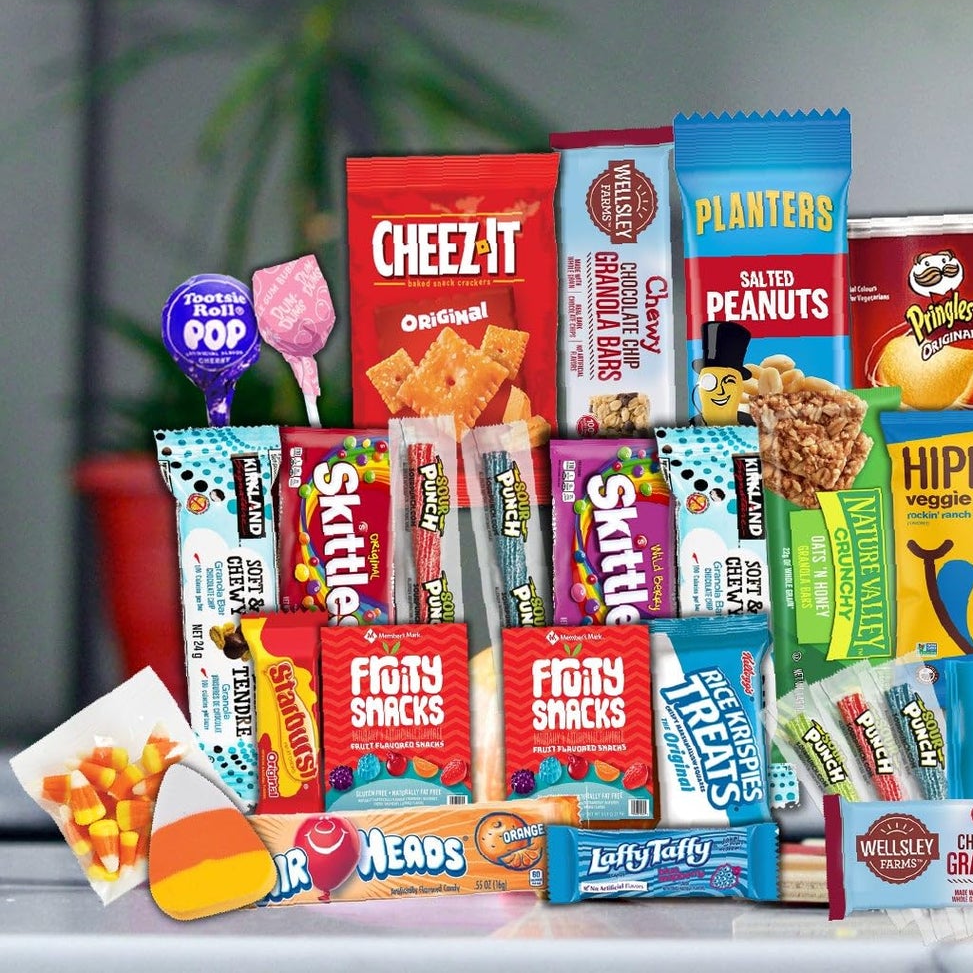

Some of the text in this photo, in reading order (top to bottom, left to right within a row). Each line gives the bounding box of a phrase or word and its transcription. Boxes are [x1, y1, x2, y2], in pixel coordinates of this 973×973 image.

[601, 185, 612, 221] FARMS
[614, 164, 632, 239] WELLSLEY
[695, 190, 834, 235] PLANTERS
[184, 292, 246, 305] Tootsie
[408, 279, 491, 287] baked snack crackers
[707, 289, 828, 321] PEANUTS
[740, 270, 794, 288] SALTED
[184, 319, 246, 350] POP
[595, 251, 622, 381] GRANOLA BARS
[620, 262, 640, 369] CHOCOLATE CHIP
[640, 276, 668, 354] Chewy
[907, 292, 973, 344] Pringles
[244, 458, 262, 535] KIRKLAND
[419, 464, 438, 532] PUNCH
[436, 476, 450, 513] SOUR
[496, 470, 520, 538] PUNCH
[514, 481, 530, 522] SOUR
[745, 458, 763, 536] KIRKLAND
[906, 491, 972, 508] veggie
[907, 511, 971, 519] rockin' ranch
[587, 474, 649, 625] Skittle
[812, 535, 825, 563] OATS
[834, 528, 854, 621] CRUNCHY
[843, 495, 885, 650] NATURE VALLEY
[227, 556, 246, 615] CHEWY
[246, 559, 264, 612] SOFT &
[725, 556, 744, 616] CHEWY
[815, 582, 830, 617] HONEY
[742, 651, 755, 695] Kellogg's
[233, 666, 252, 737] TENDRE
[269, 663, 318, 778] Starburst
[351, 742, 374, 750] FRUIT
[667, 675, 740, 807] TREATS
[703, 670, 762, 800] RICE KRISPIES
[803, 727, 844, 783] PUNCH
[856, 711, 893, 774] PUNCH
[903, 701, 937, 767] PUNCH
[922, 711, 943, 747] SOUR
[266, 752, 278, 798] Original
[664, 732, 695, 792] Original
[503, 824, 544, 843] ORANGE
[590, 838, 712, 873] Laffy Taffy
[860, 838, 934, 858] WELLSLEY
[257, 828, 465, 905] IR HEADS
[880, 859, 916, 870] FARMS
